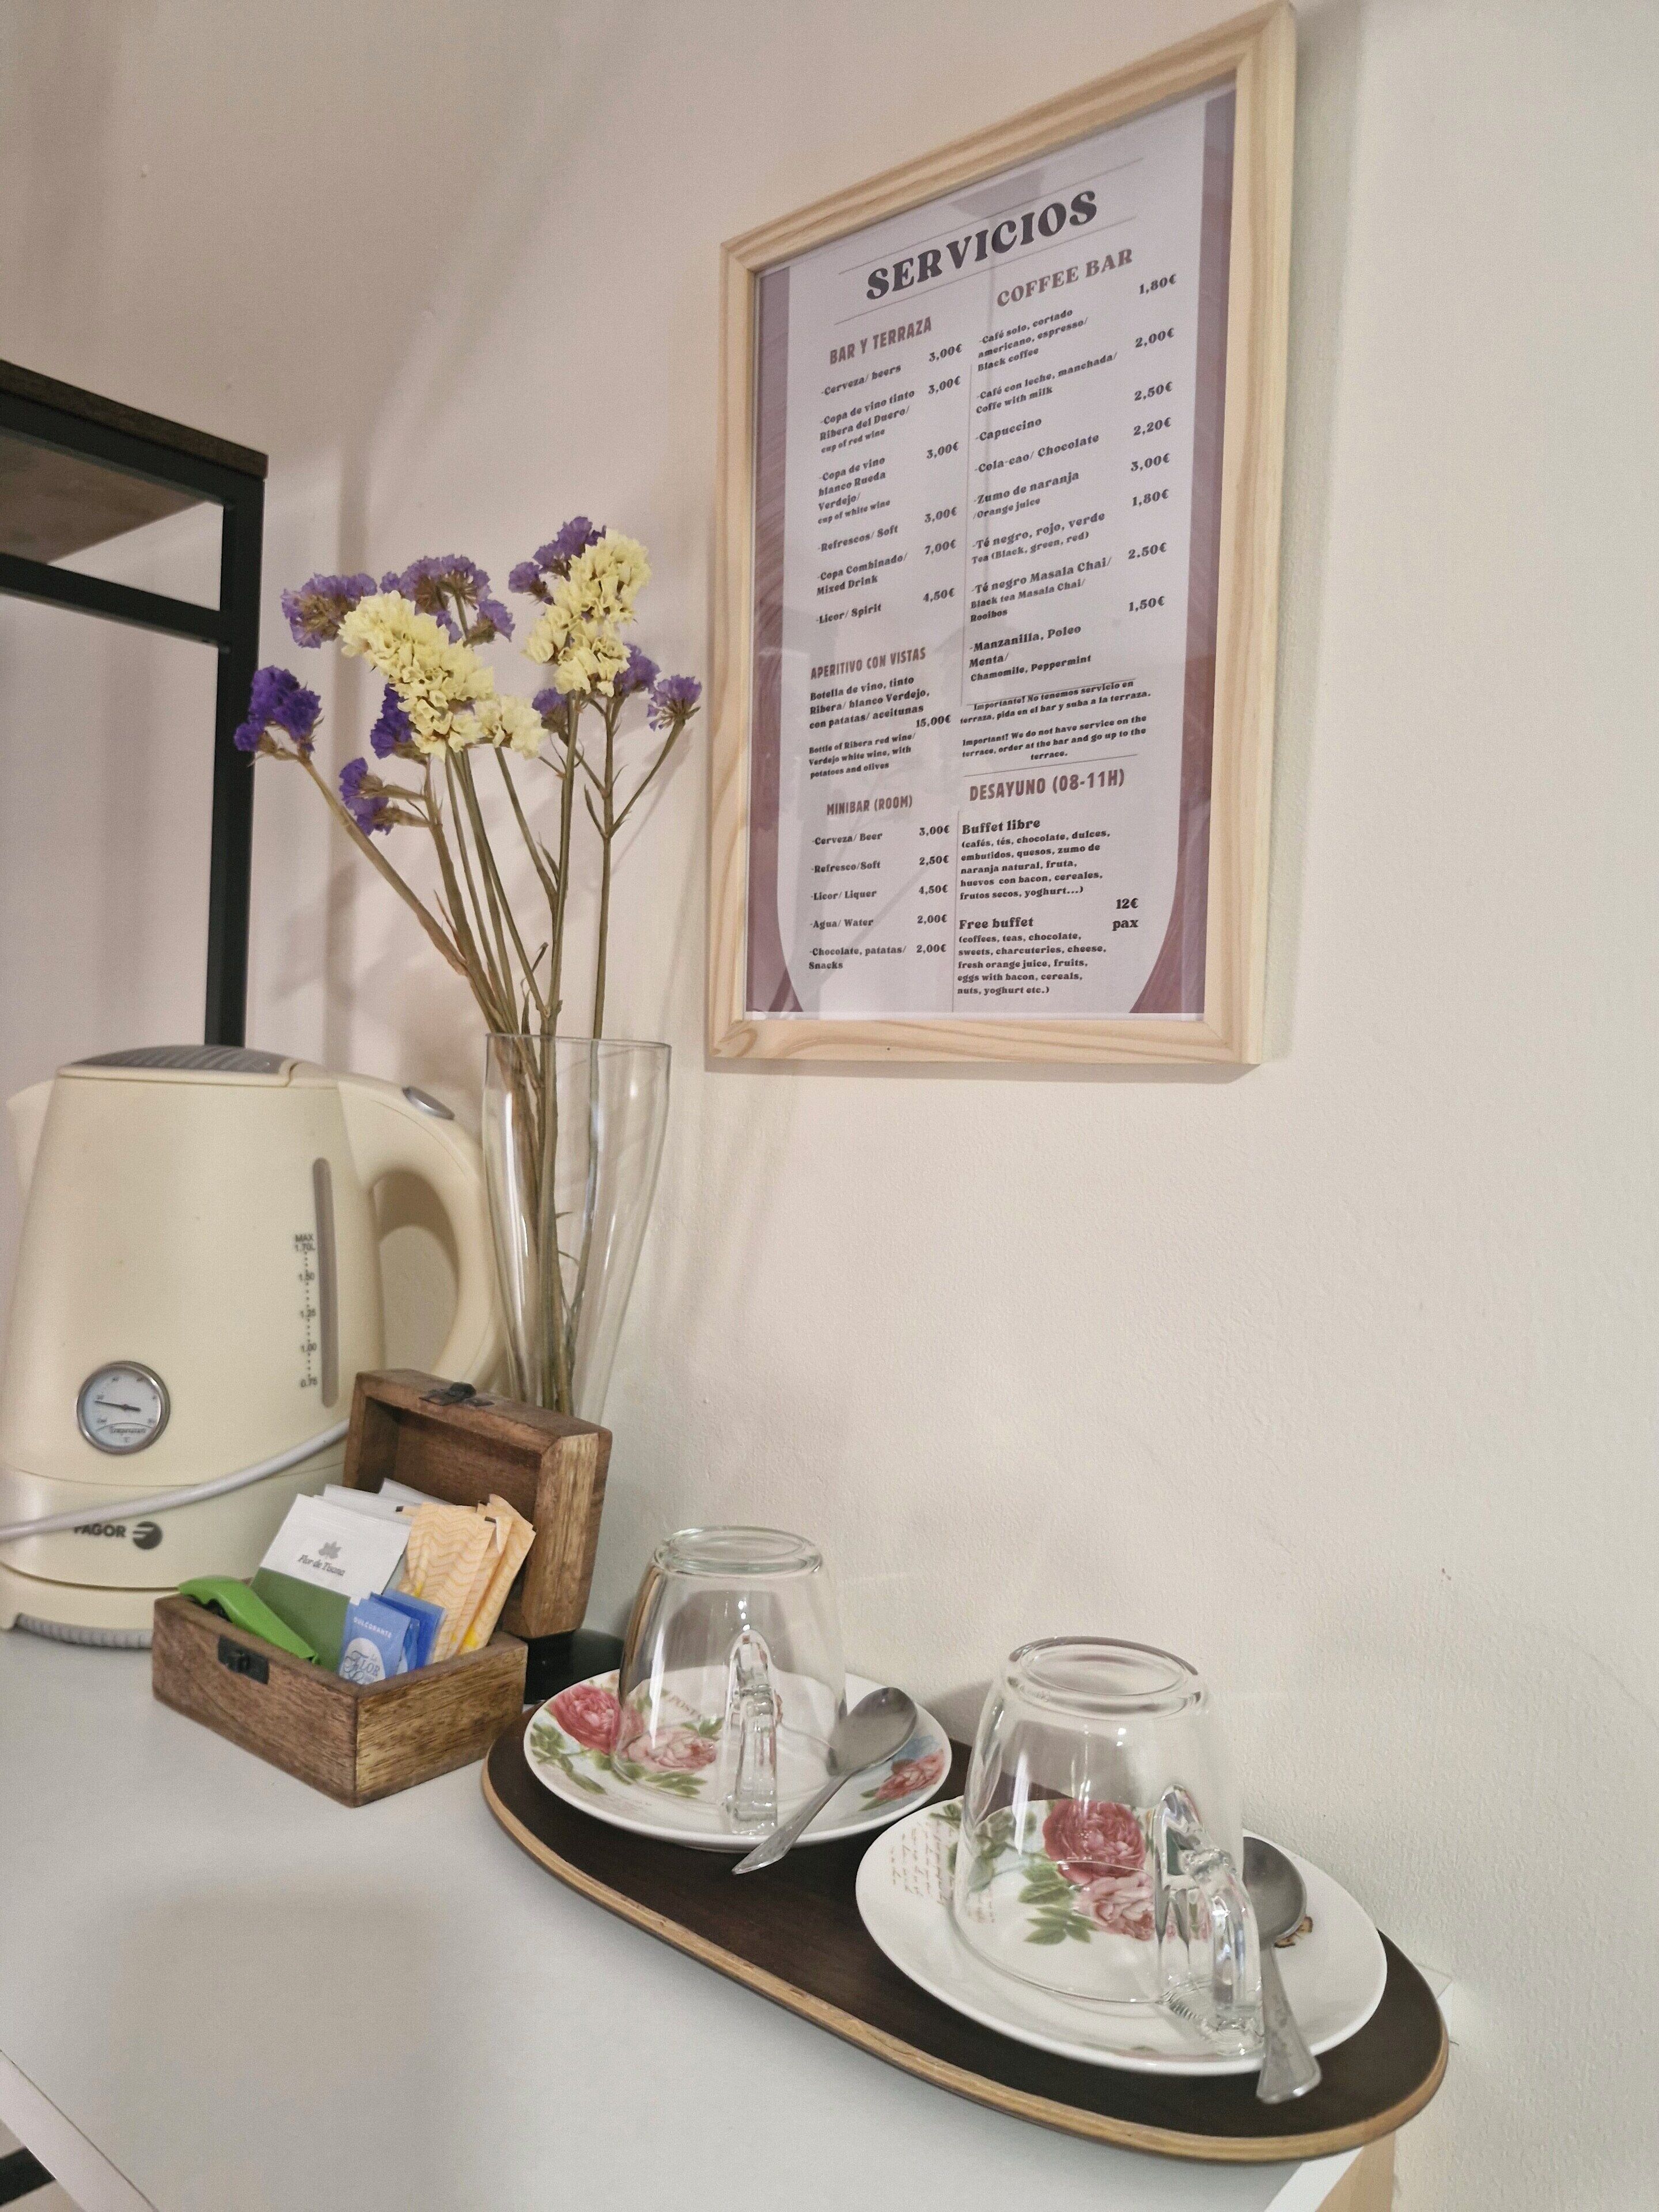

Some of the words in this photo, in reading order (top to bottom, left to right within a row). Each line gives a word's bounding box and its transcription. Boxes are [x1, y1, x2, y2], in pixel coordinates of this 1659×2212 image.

[866, 190, 1097, 300] SERVICIOS
[997, 266, 1079, 307] COFFEE
[1085, 248, 1132, 278] BAR
[830, 342, 855, 365] BAR
[859, 337, 868, 355] Y
[872, 316, 932, 350] TERRAZA
[871, 364, 902, 381] beers
[849, 407, 862, 417] de
[863, 399, 887, 412] vino
[888, 390, 915, 404] tinto
[1037, 434, 1099, 458] Chocolate
[848, 464, 861, 474] de
[862, 457, 885, 469] vino
[1012, 484, 1027, 496] de
[1029, 471, 1080, 492] naranja
[817, 493, 860, 511] Verdejo/
[1067, 512, 1105, 528] verde
[876, 524, 898, 538] Soft
[845, 552, 908, 575] Combinado/
[991, 577, 1027, 591] negro
[1029, 566, 1074, 583] Masala
[1077, 556, 1112, 573] Chai/
[851, 603, 881, 619] Spirit
[1047, 626, 1081, 639] Poleo
[810, 658, 863, 680] APERITIVO
[866, 654, 887, 670] CON
[889, 646, 926, 665] VISTAS
[968, 653, 1009, 668] Menta/
[1031, 654, 1092, 672] Peppermint
[809, 688, 844, 701] Botella
[846, 685, 858, 695] de
[889, 676, 915, 688] tinto
[809, 702, 846, 715] Ribera/
[849, 696, 884, 709] blanco
[809, 720, 827, 730] con
[828, 712, 870, 729] patatas/
[872, 704, 924, 720] aceitunas
[1010, 732, 1024, 740] We
[1025, 729, 1037, 738] do
[1037, 727, 1053, 736] not
[1054, 725, 1077, 734] have
[1079, 719, 1115, 730] service
[1130, 714, 1147, 724] the
[969, 777, 1046, 802] DESAYUNO
[1052, 768, 1125, 794] (08-11H)
[826, 799, 870, 816] MINIBAR
[873, 794, 913, 812] (ROOM)
[961, 821, 1003, 835] Buffet
[1006, 819, 1041, 831] libre
[859, 832, 883, 842] Beer
[1057, 846, 1086, 854] zumo
[1087, 843, 1100, 852] de
[960, 863, 999, 874] naranja
[960, 878, 995, 887] huevos
[844, 889, 877, 900] Liquer
[959, 892, 990, 900] frutos
[1116, 897, 1139, 910] 12€
[843, 918, 874, 927] Water
[959, 919, 988, 930] Free
[991, 916, 1033, 929] buffet
[1111, 919, 1139, 931] pax
[864, 945, 907, 957] patatas/
[808, 960, 843, 970] Snacks
[957, 960, 984, 969] fresh
[985, 960, 1021, 970] orange
[957, 974, 979, 984] eggs
[981, 972, 1003, 981] with
[983, 986, 1024, 997] yoghurt
[295, 1233, 313, 1242] MAX
